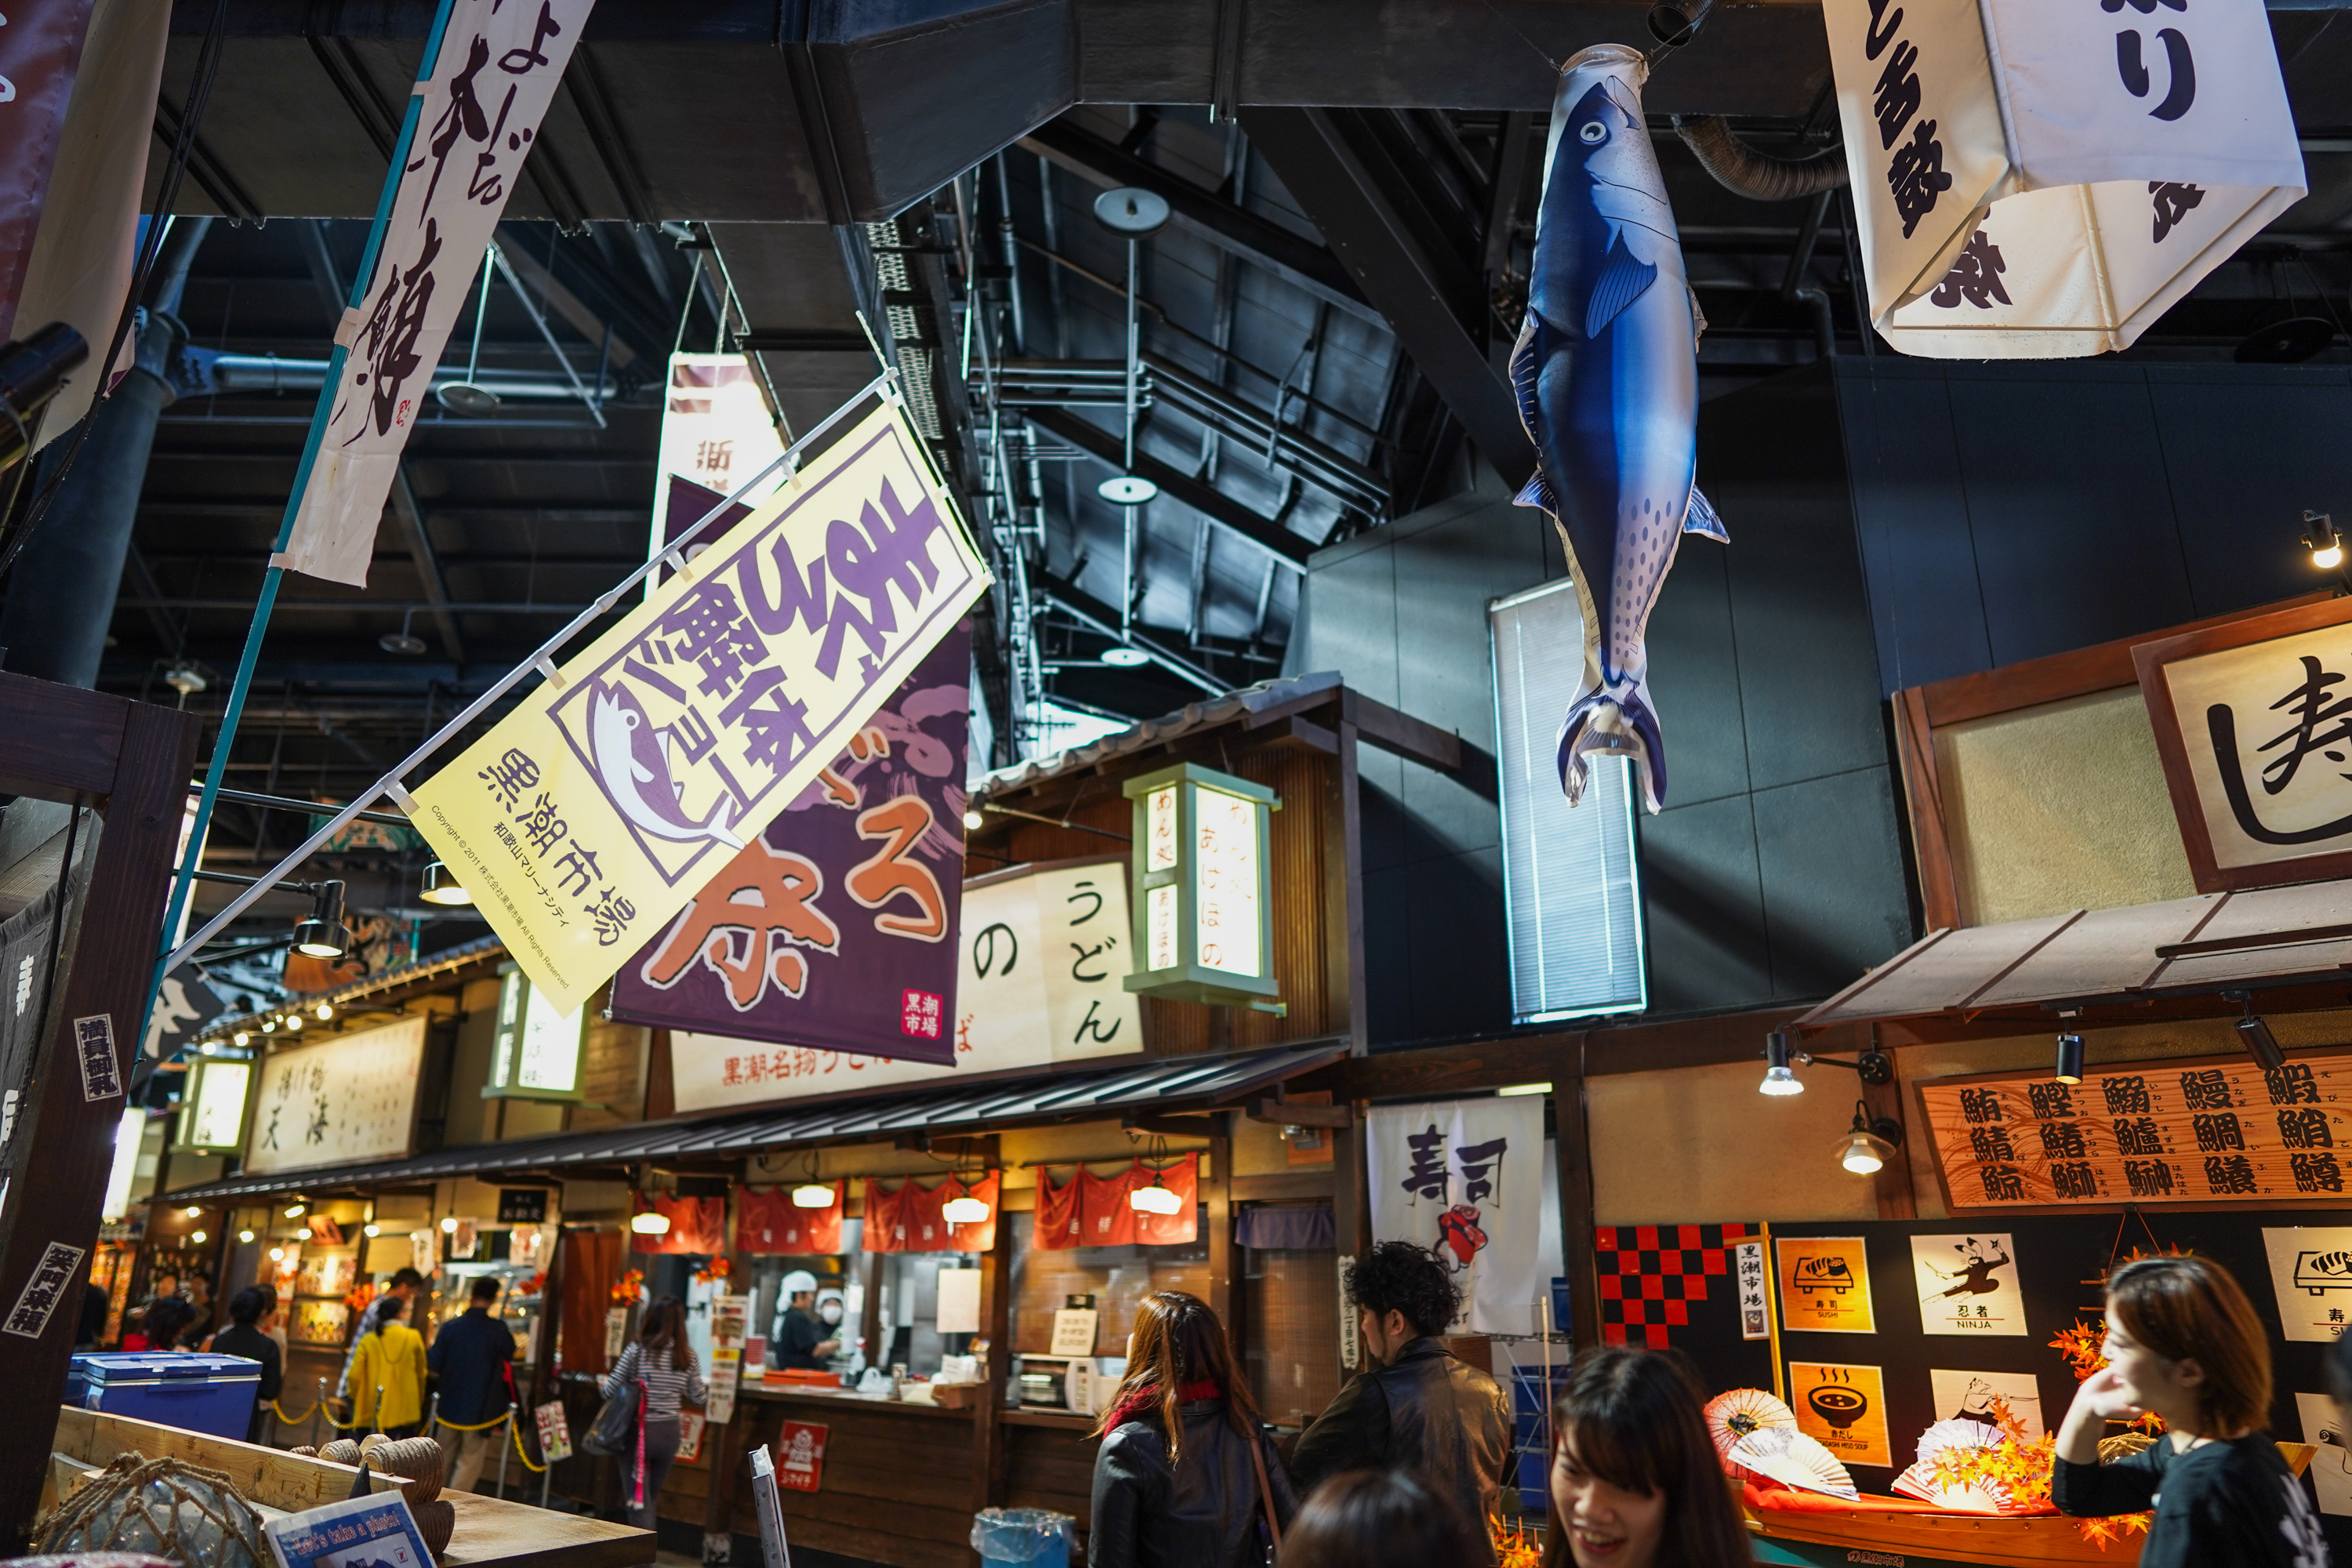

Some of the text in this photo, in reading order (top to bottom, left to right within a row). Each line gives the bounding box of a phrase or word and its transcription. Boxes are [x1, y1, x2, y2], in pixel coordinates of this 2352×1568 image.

[737, 474, 939, 687] まぐろ
[662, 581, 815, 775] 解体
[622, 639, 753, 812] ショー
[477, 748, 636, 946] 黒潮市場
[493, 822, 570, 927] 和歌山マリーナシティ
[431, 805, 460, 843] Copyright
[464, 848, 481, 866] 2011
[478, 865, 524, 927] 株式会社黒潮市場
[521, 925, 530, 936] All
[528, 935, 544, 957] Rights
[543, 956, 570, 991] Reserved.
[1067, 881, 1121, 1044] うどん
[905, 993, 938, 1017] 黒潮
[904, 1013, 938, 1037] 市場
[1960, 1087, 2014, 1123] 鮪 まぐろ
[2029, 1083, 2089, 1120] 鰹 かつお
[2102, 1076, 2164, 1115] 鰯 いわし
[2180, 1069, 2248, 1110] 鰻 うなぎ
[1970, 1126, 2014, 1163] 鯖
[2039, 1122, 2099, 1160] 鰆 さわら
[2113, 1117, 2176, 1156] 鱸 すずき
[2192, 1112, 2260, 1152] 鯛 たい
[2332, 1116, 2350, 1148] たこ
[1401, 1124, 1507, 1208] 寿司
[1980, 1164, 2036, 1201] 鯨 くじら
[2050, 1162, 2110, 1199] 鰤 はまち
[2257, 1163, 2274, 1194] ふか
[2290, 1152, 2345, 1192] 鱒
[1740, 1245, 1762, 1306] 黒潮市場
[1817, 1300, 1838, 1309] 寿司
[1958, 1305, 1987, 1318] 忍者
[1831, 1430, 1853, 1439] 赤だし
[293, 1511, 401, 1555] Let's take a photo!
